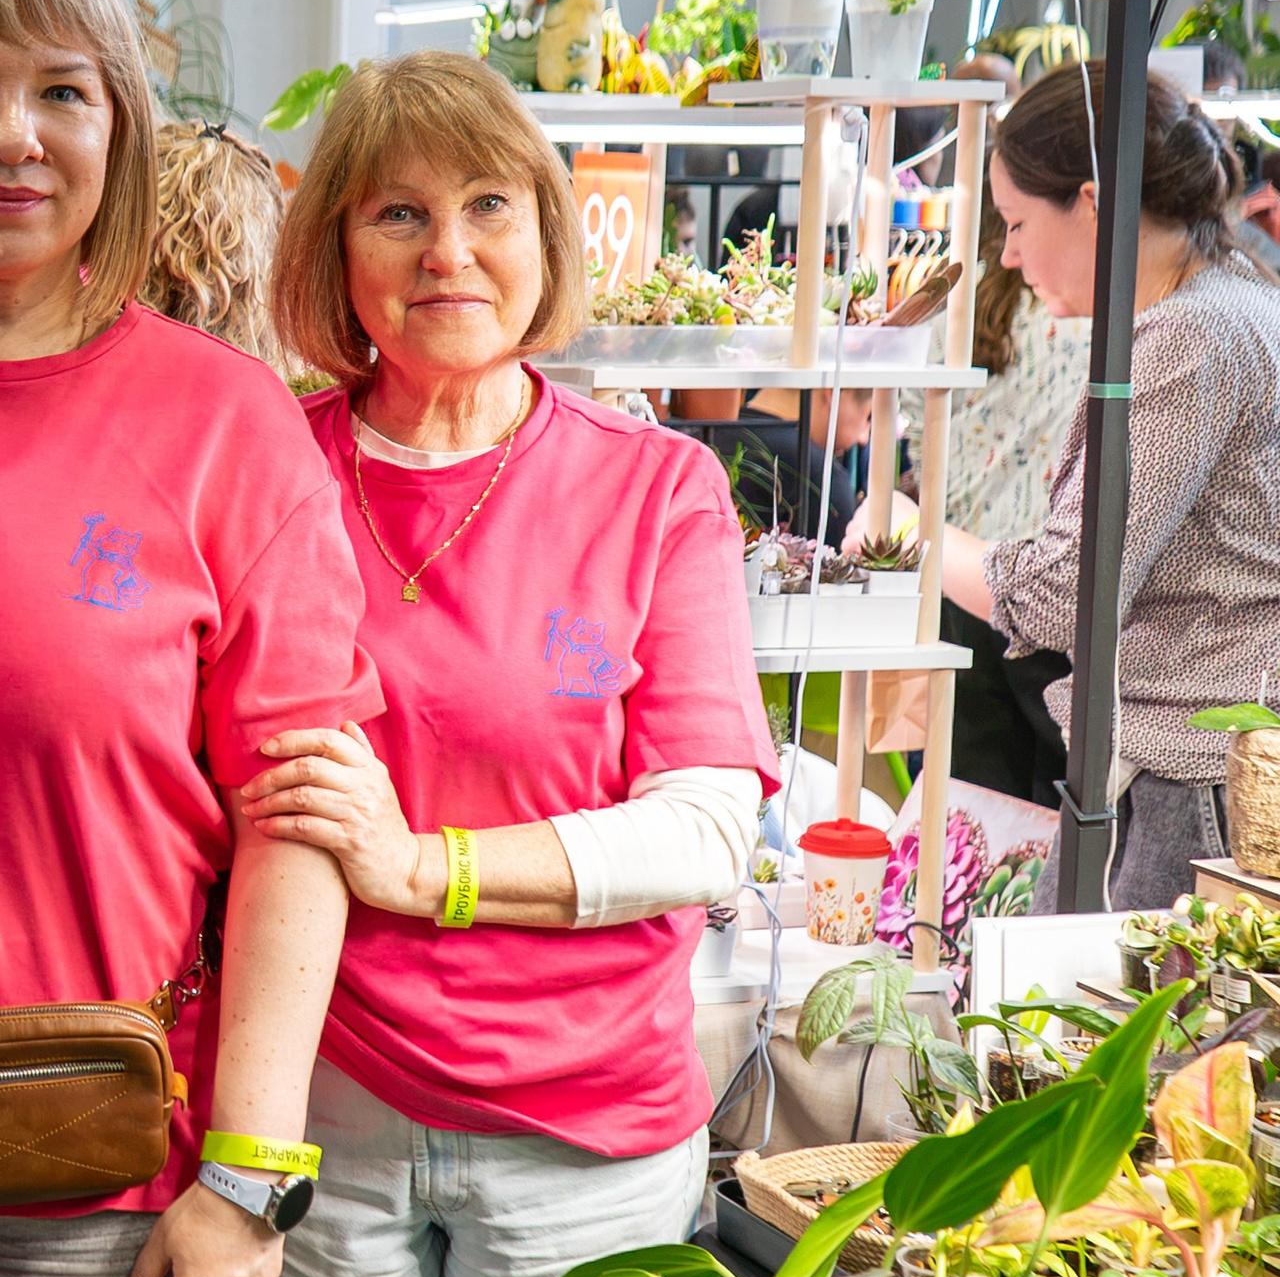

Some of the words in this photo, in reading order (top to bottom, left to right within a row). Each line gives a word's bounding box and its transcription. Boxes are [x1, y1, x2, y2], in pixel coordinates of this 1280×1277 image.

[582, 192, 634, 292] 89
[453, 860, 471, 921] ГРОУБОКС
[252, 1145, 300, 1163] МАРКЕТ
